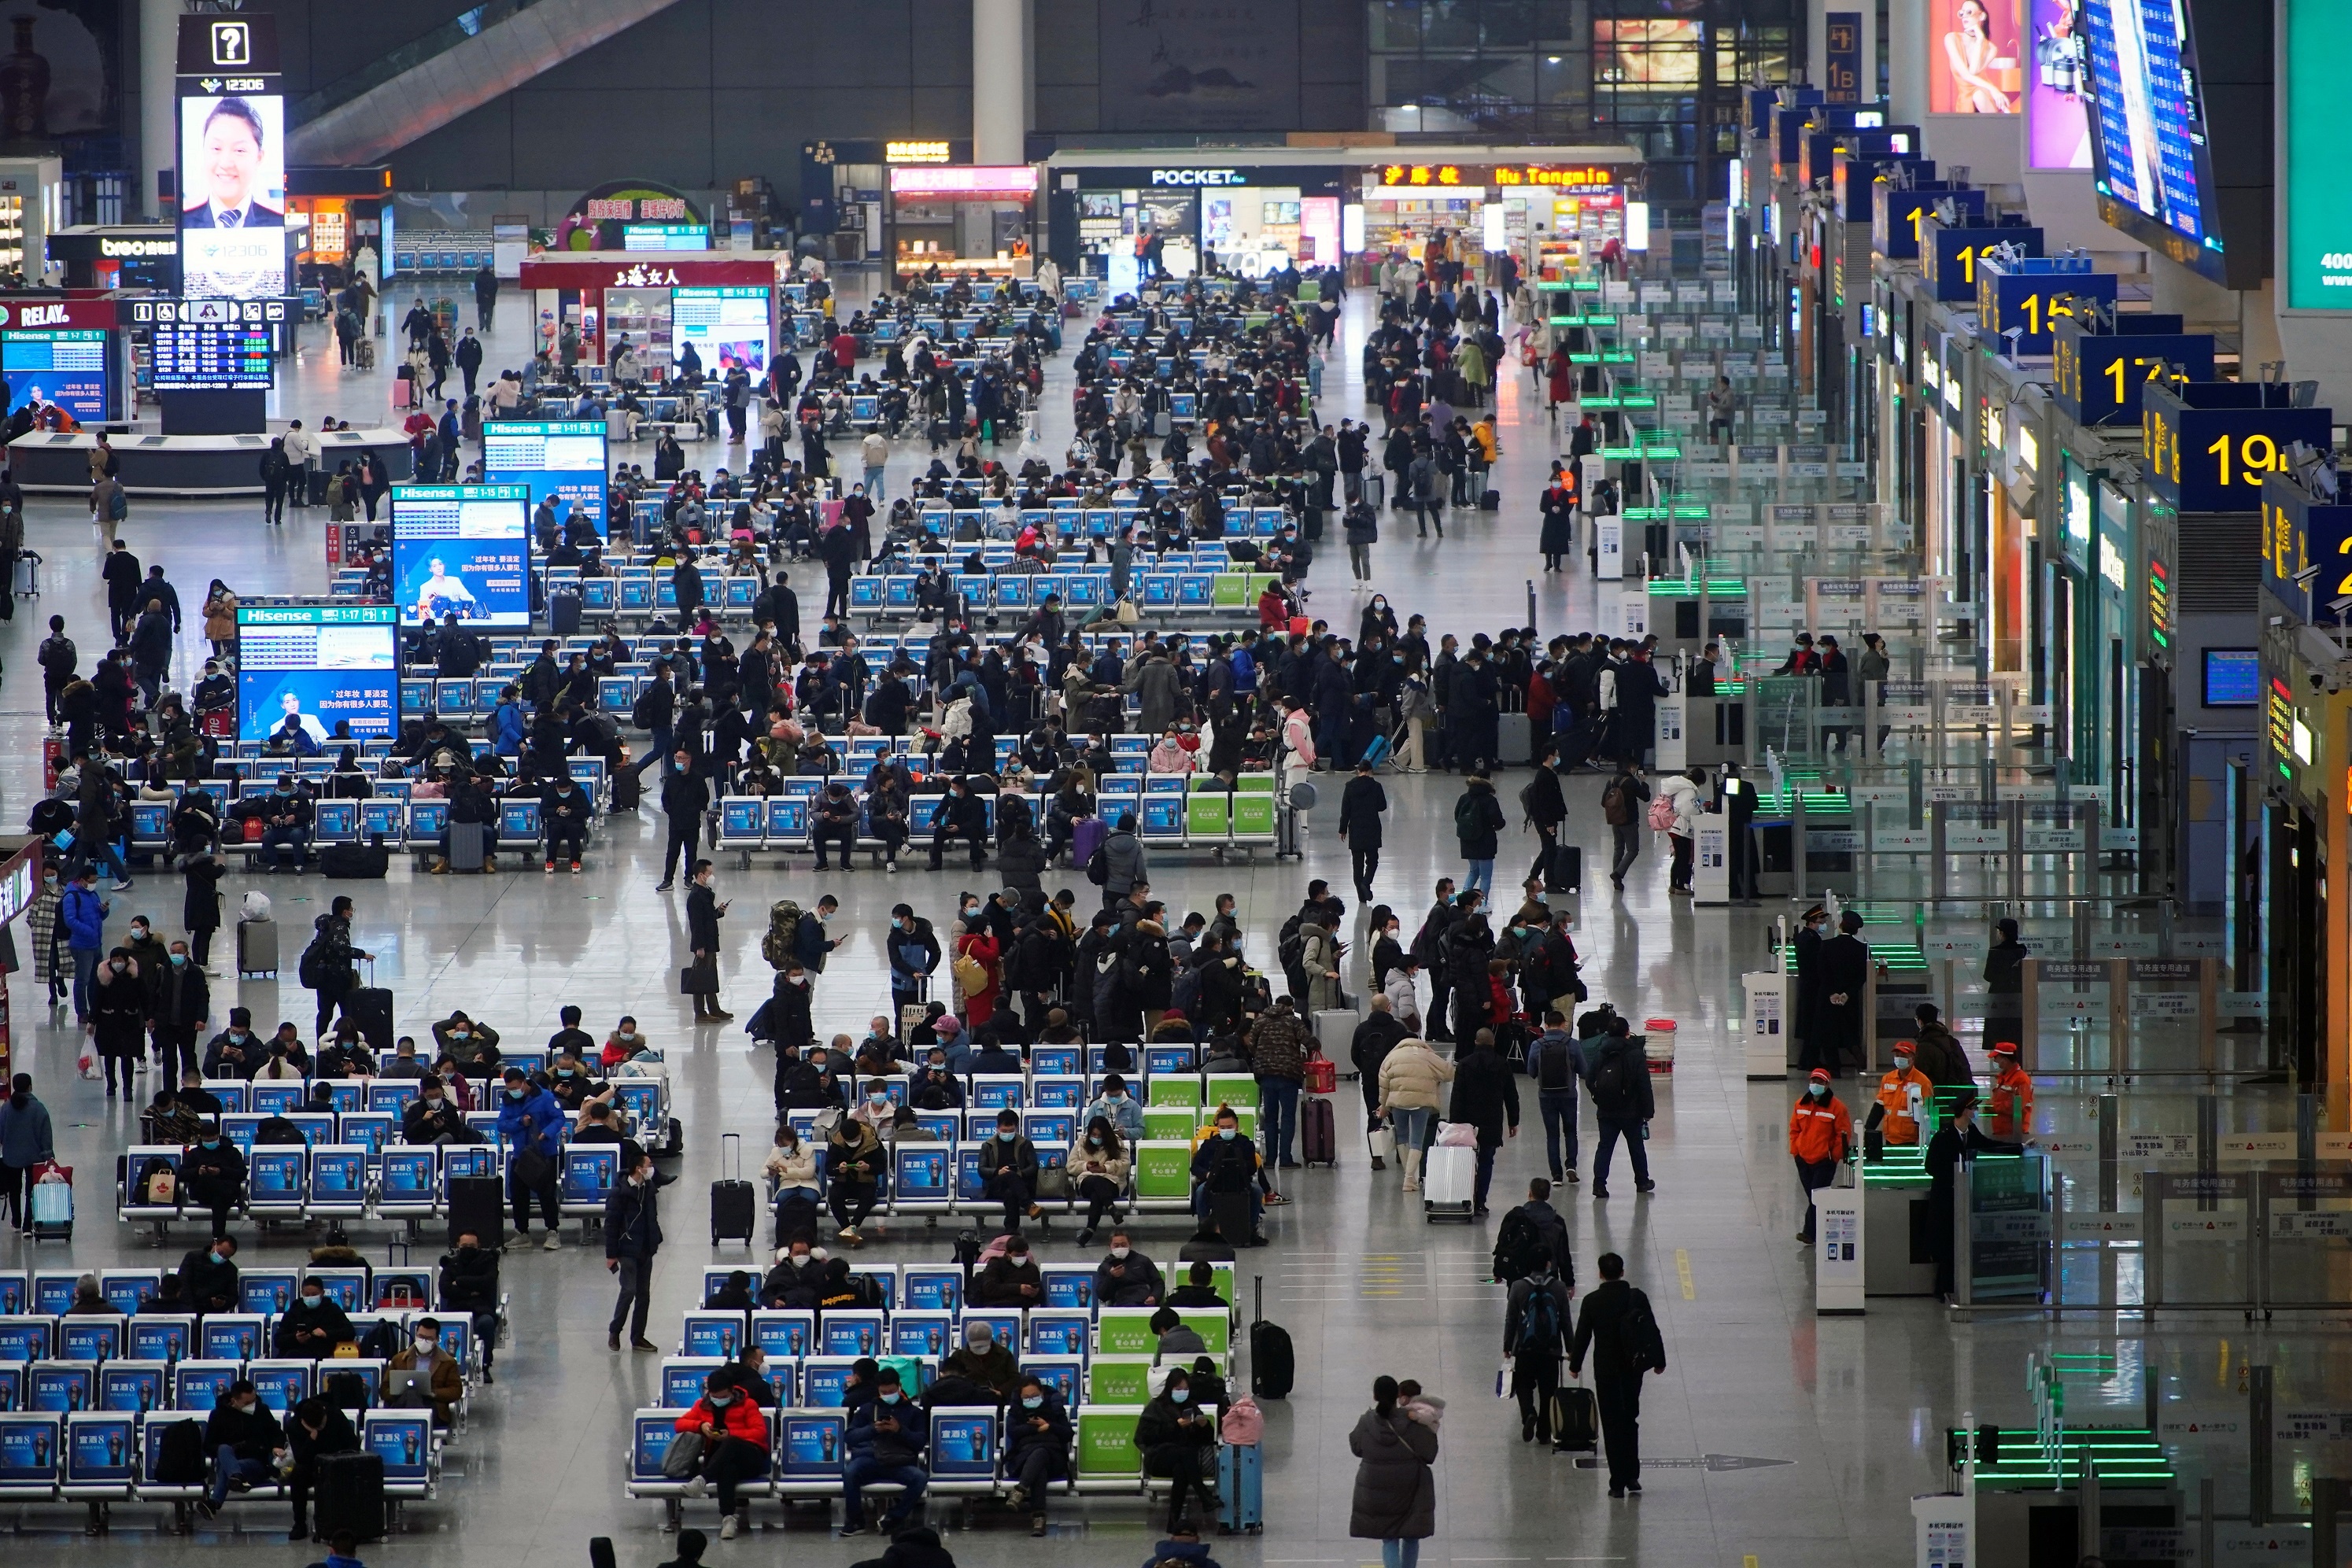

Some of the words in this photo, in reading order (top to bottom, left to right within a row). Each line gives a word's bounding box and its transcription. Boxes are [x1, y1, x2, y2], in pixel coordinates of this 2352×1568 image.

[1830, 61, 1853, 88] 1B
[226, 79, 264, 90] 12306
[1152, 170, 1235, 184] POCKET
[1496, 168, 1521, 184] Hu
[588, 199, 632, 220] 殷殷家国情
[641, 198, 685, 219] 温暖伴你行
[102, 239, 144, 256] breo
[223, 245, 268, 257] 12306
[615, 264, 680, 286] 上海女人
[8, 331, 51, 340] Hisense
[491, 424, 541, 434] Hisense
[563, 423, 578, 432] 1-11
[2208, 434, 2288, 485] 19
[401, 488, 456, 498] Hisense
[480, 488, 496, 496] 1-15
[247, 610, 312, 622] Hisense
[342, 610, 360, 620] 1-17
[335, 689, 360, 698] 过年妆
[364, 689, 389, 698] 要淡定
[2046, 964, 2101, 973] 商务座专用通道
[2136, 964, 2191, 973] 商务座专用通道
[2173, 1179, 2236, 1188] 商务座专用通道
[2280, 1178, 2343, 1187] 商务座专用通道
